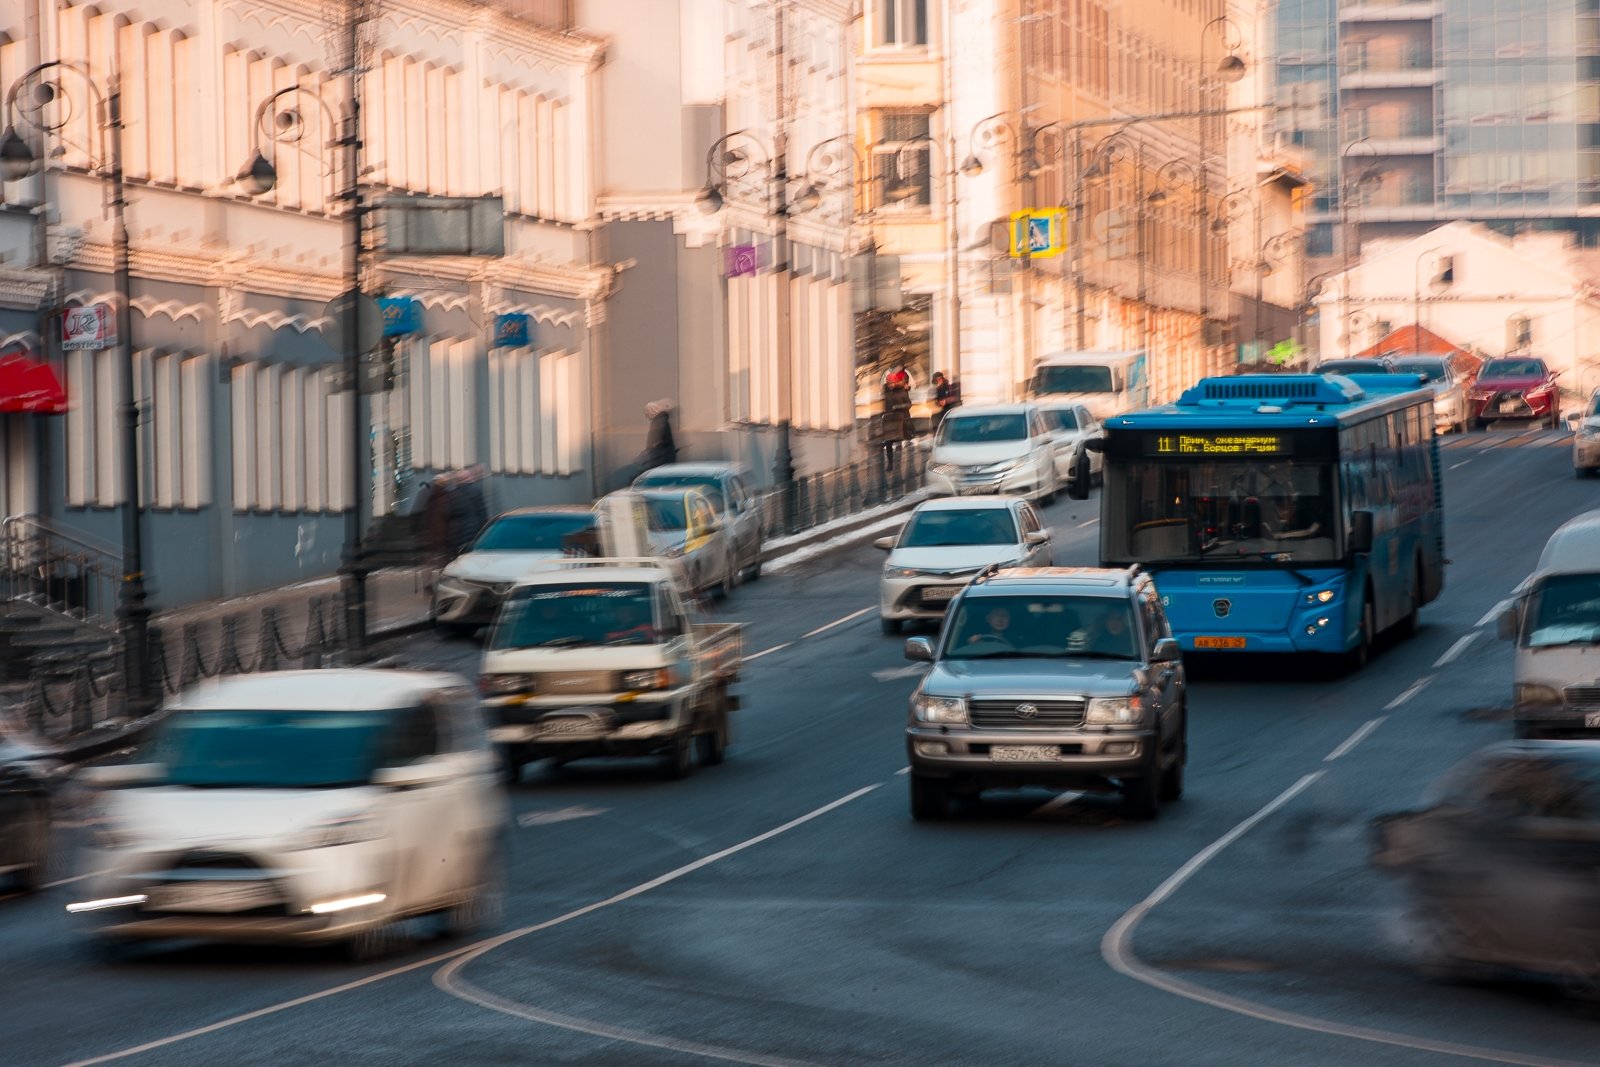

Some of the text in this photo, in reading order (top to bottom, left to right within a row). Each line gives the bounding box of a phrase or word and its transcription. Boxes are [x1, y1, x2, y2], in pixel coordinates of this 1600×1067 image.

[1158, 437, 1172, 452] 11
[1179, 436, 1277, 445] Прим. океанариум
[1179, 444, 1197, 452] Пл.
[1203, 443, 1240, 452] Борцов
[1212, 638, 1230, 648] 936
